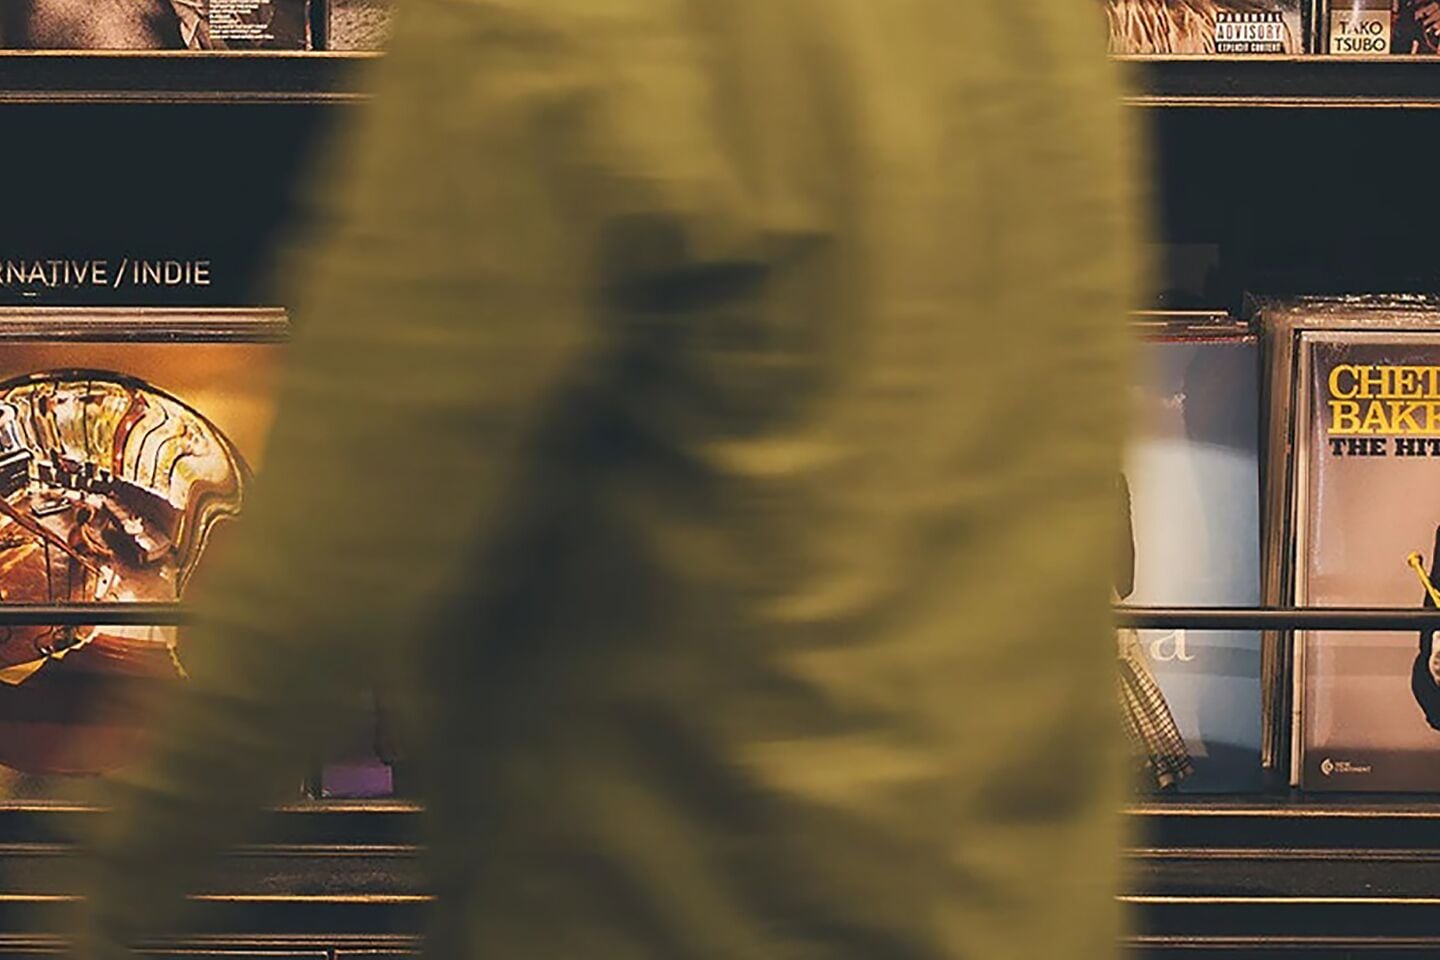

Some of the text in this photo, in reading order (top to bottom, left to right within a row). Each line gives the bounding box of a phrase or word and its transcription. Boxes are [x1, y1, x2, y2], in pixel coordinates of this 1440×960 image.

[1218, 12, 1281, 22] PARENTAL
[1217, 24, 1281, 39] ADVISORY
[1334, 37, 1386, 52] TSUBO
[1328, 365, 1440, 400] CHET
[1328, 437, 1387, 456] THE
